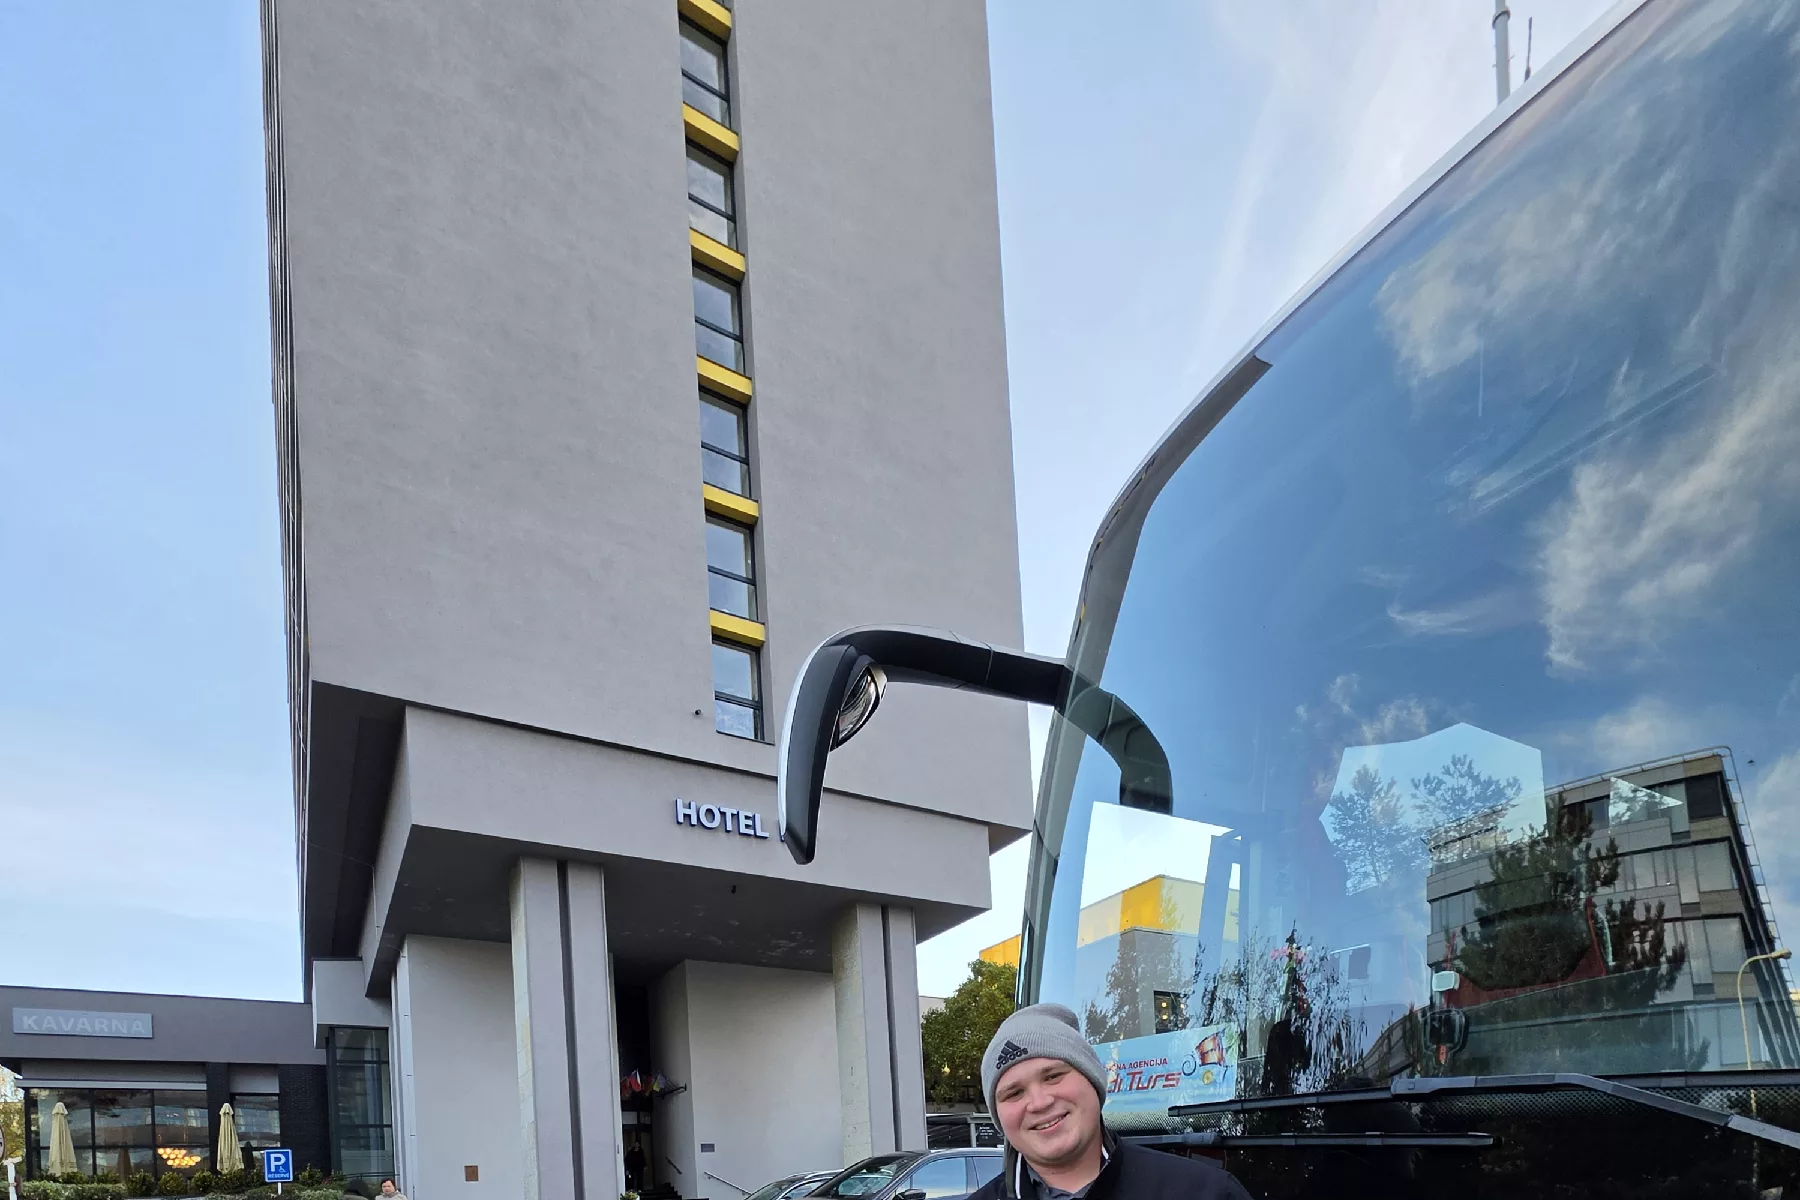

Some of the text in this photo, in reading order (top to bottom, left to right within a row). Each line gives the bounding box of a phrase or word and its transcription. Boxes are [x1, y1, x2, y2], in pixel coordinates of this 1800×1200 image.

[676, 799, 770, 839] HOTEL
[996, 1047, 1029, 1070] adidas
[1128, 1058, 1168, 1069] AGENCIJA
[1126, 1071, 1182, 1092] Turs
[270, 1153, 286, 1172] P
